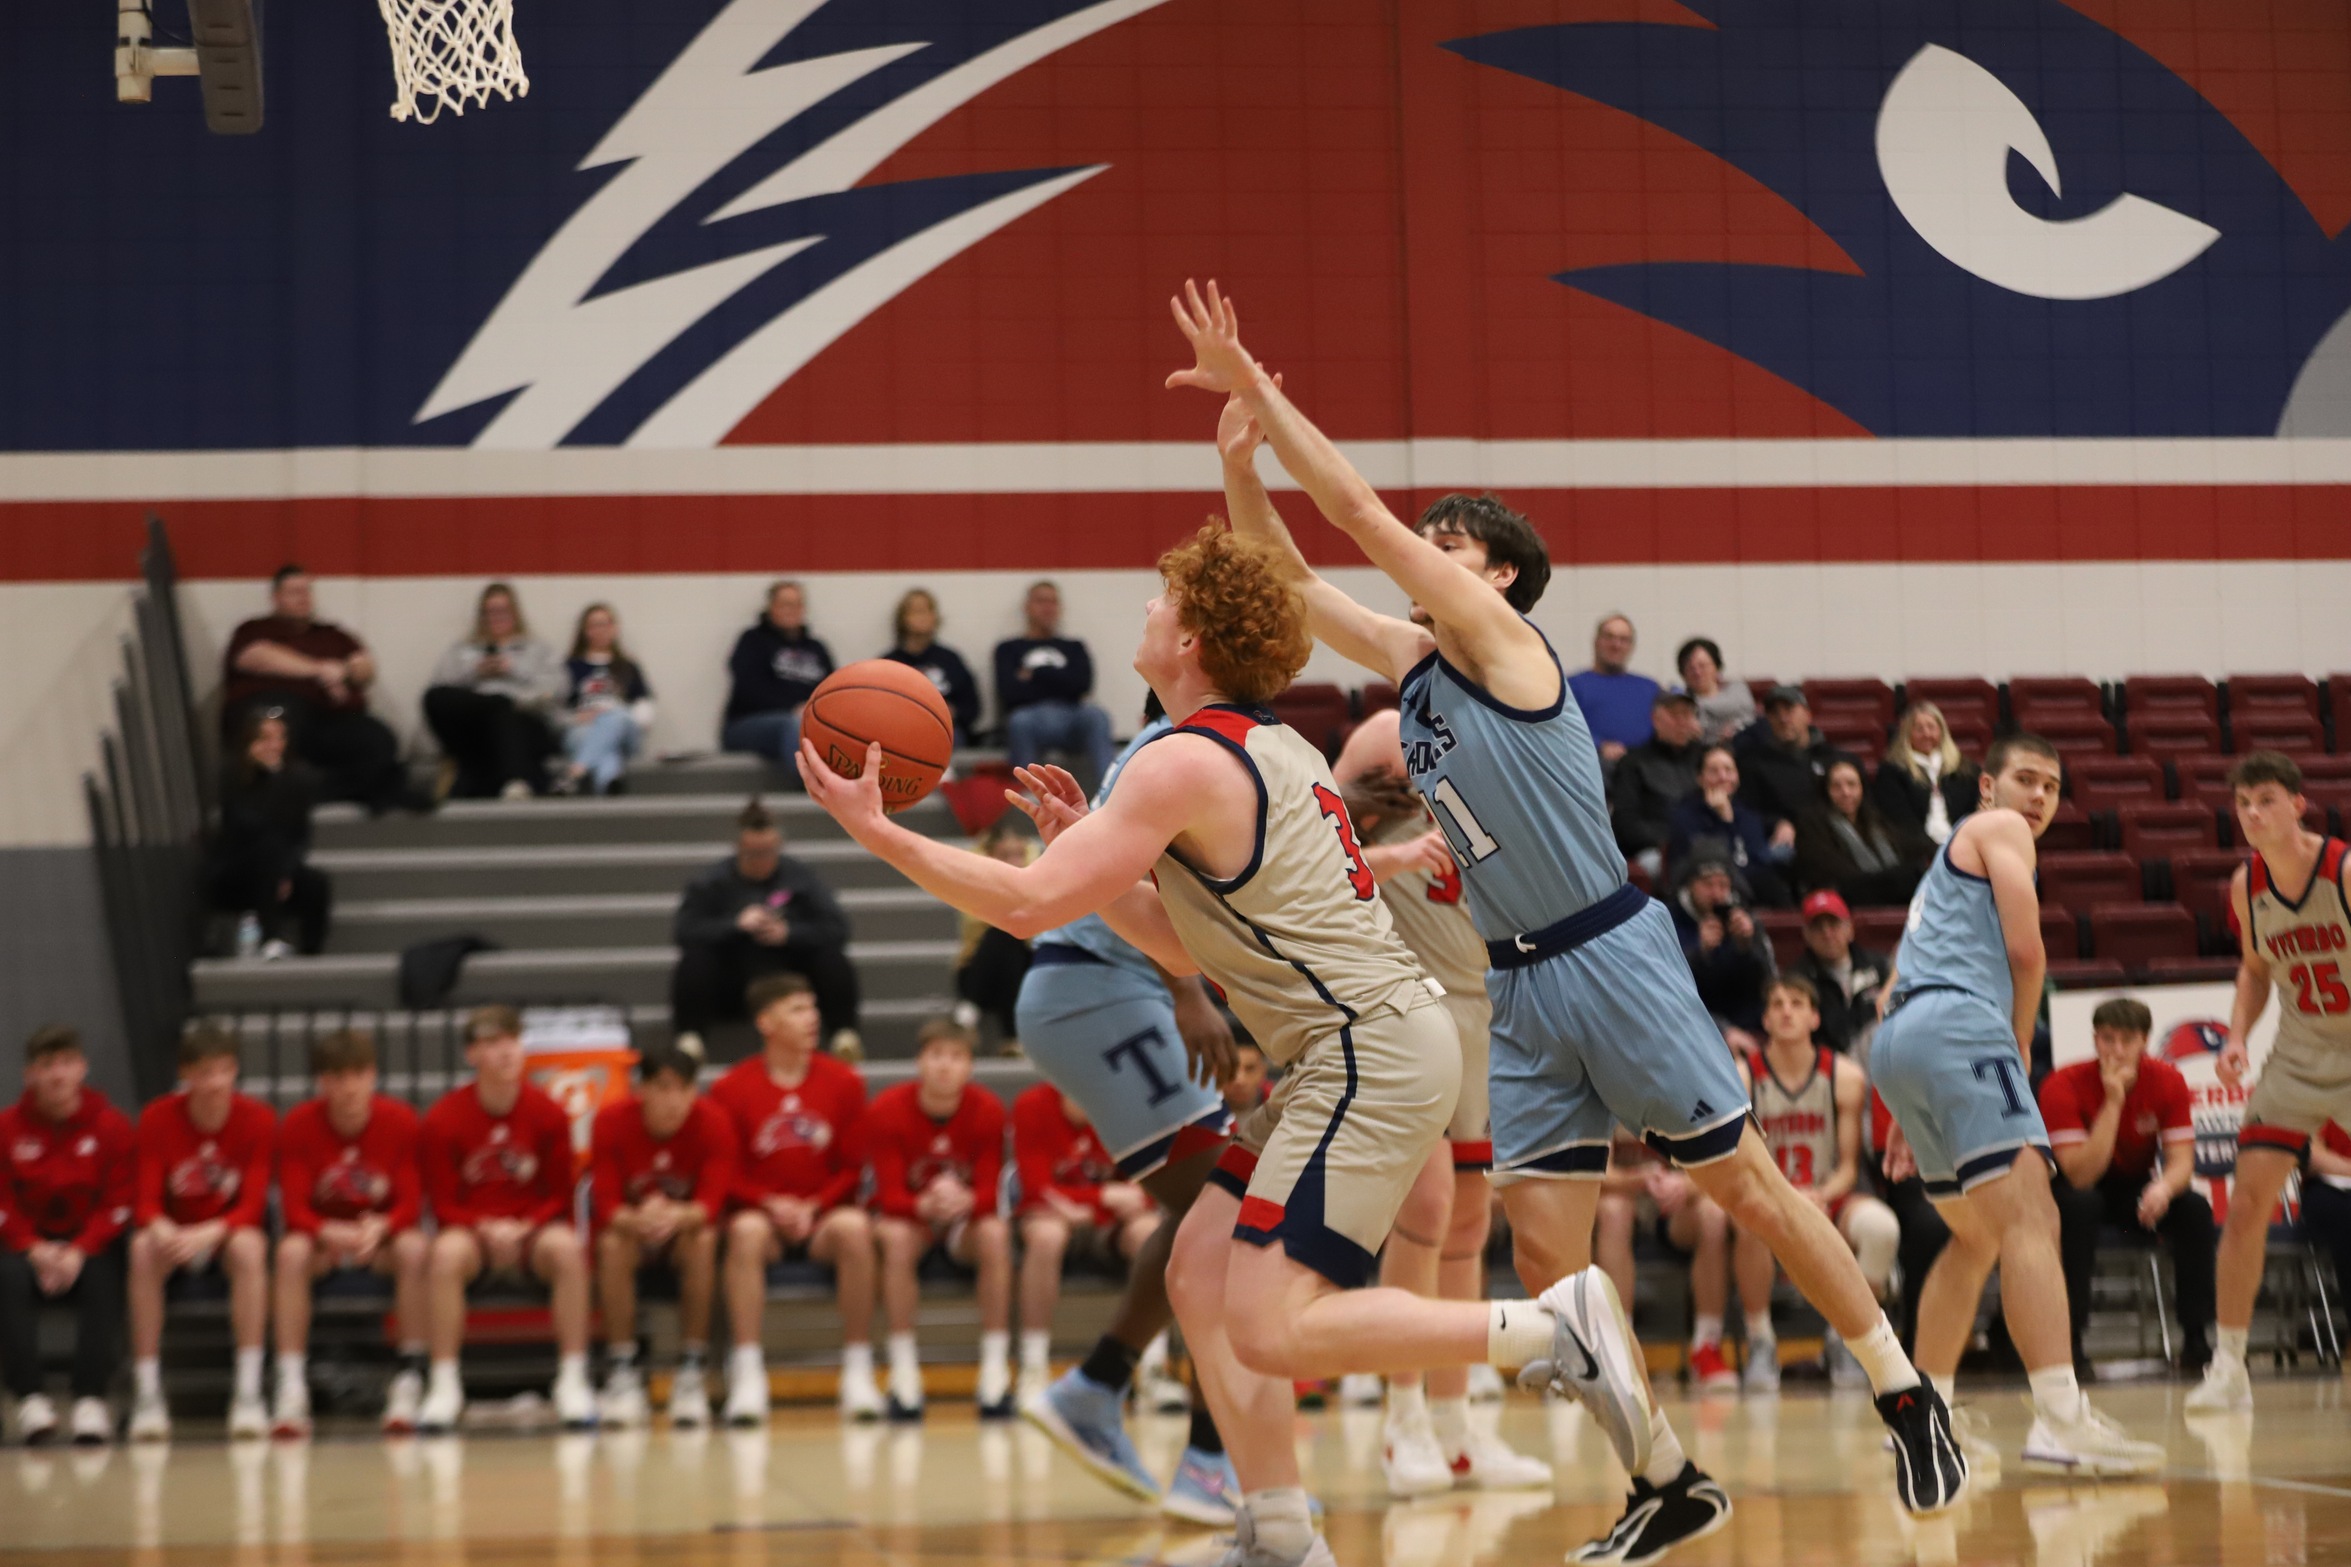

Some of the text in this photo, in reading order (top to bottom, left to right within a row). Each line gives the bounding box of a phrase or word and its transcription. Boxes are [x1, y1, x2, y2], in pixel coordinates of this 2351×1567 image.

[822, 743, 923, 796] SPADING
[2289, 961, 2350, 1015] 25
[1102, 1026, 1182, 1109] T
[1970, 1057, 2031, 1120] T
